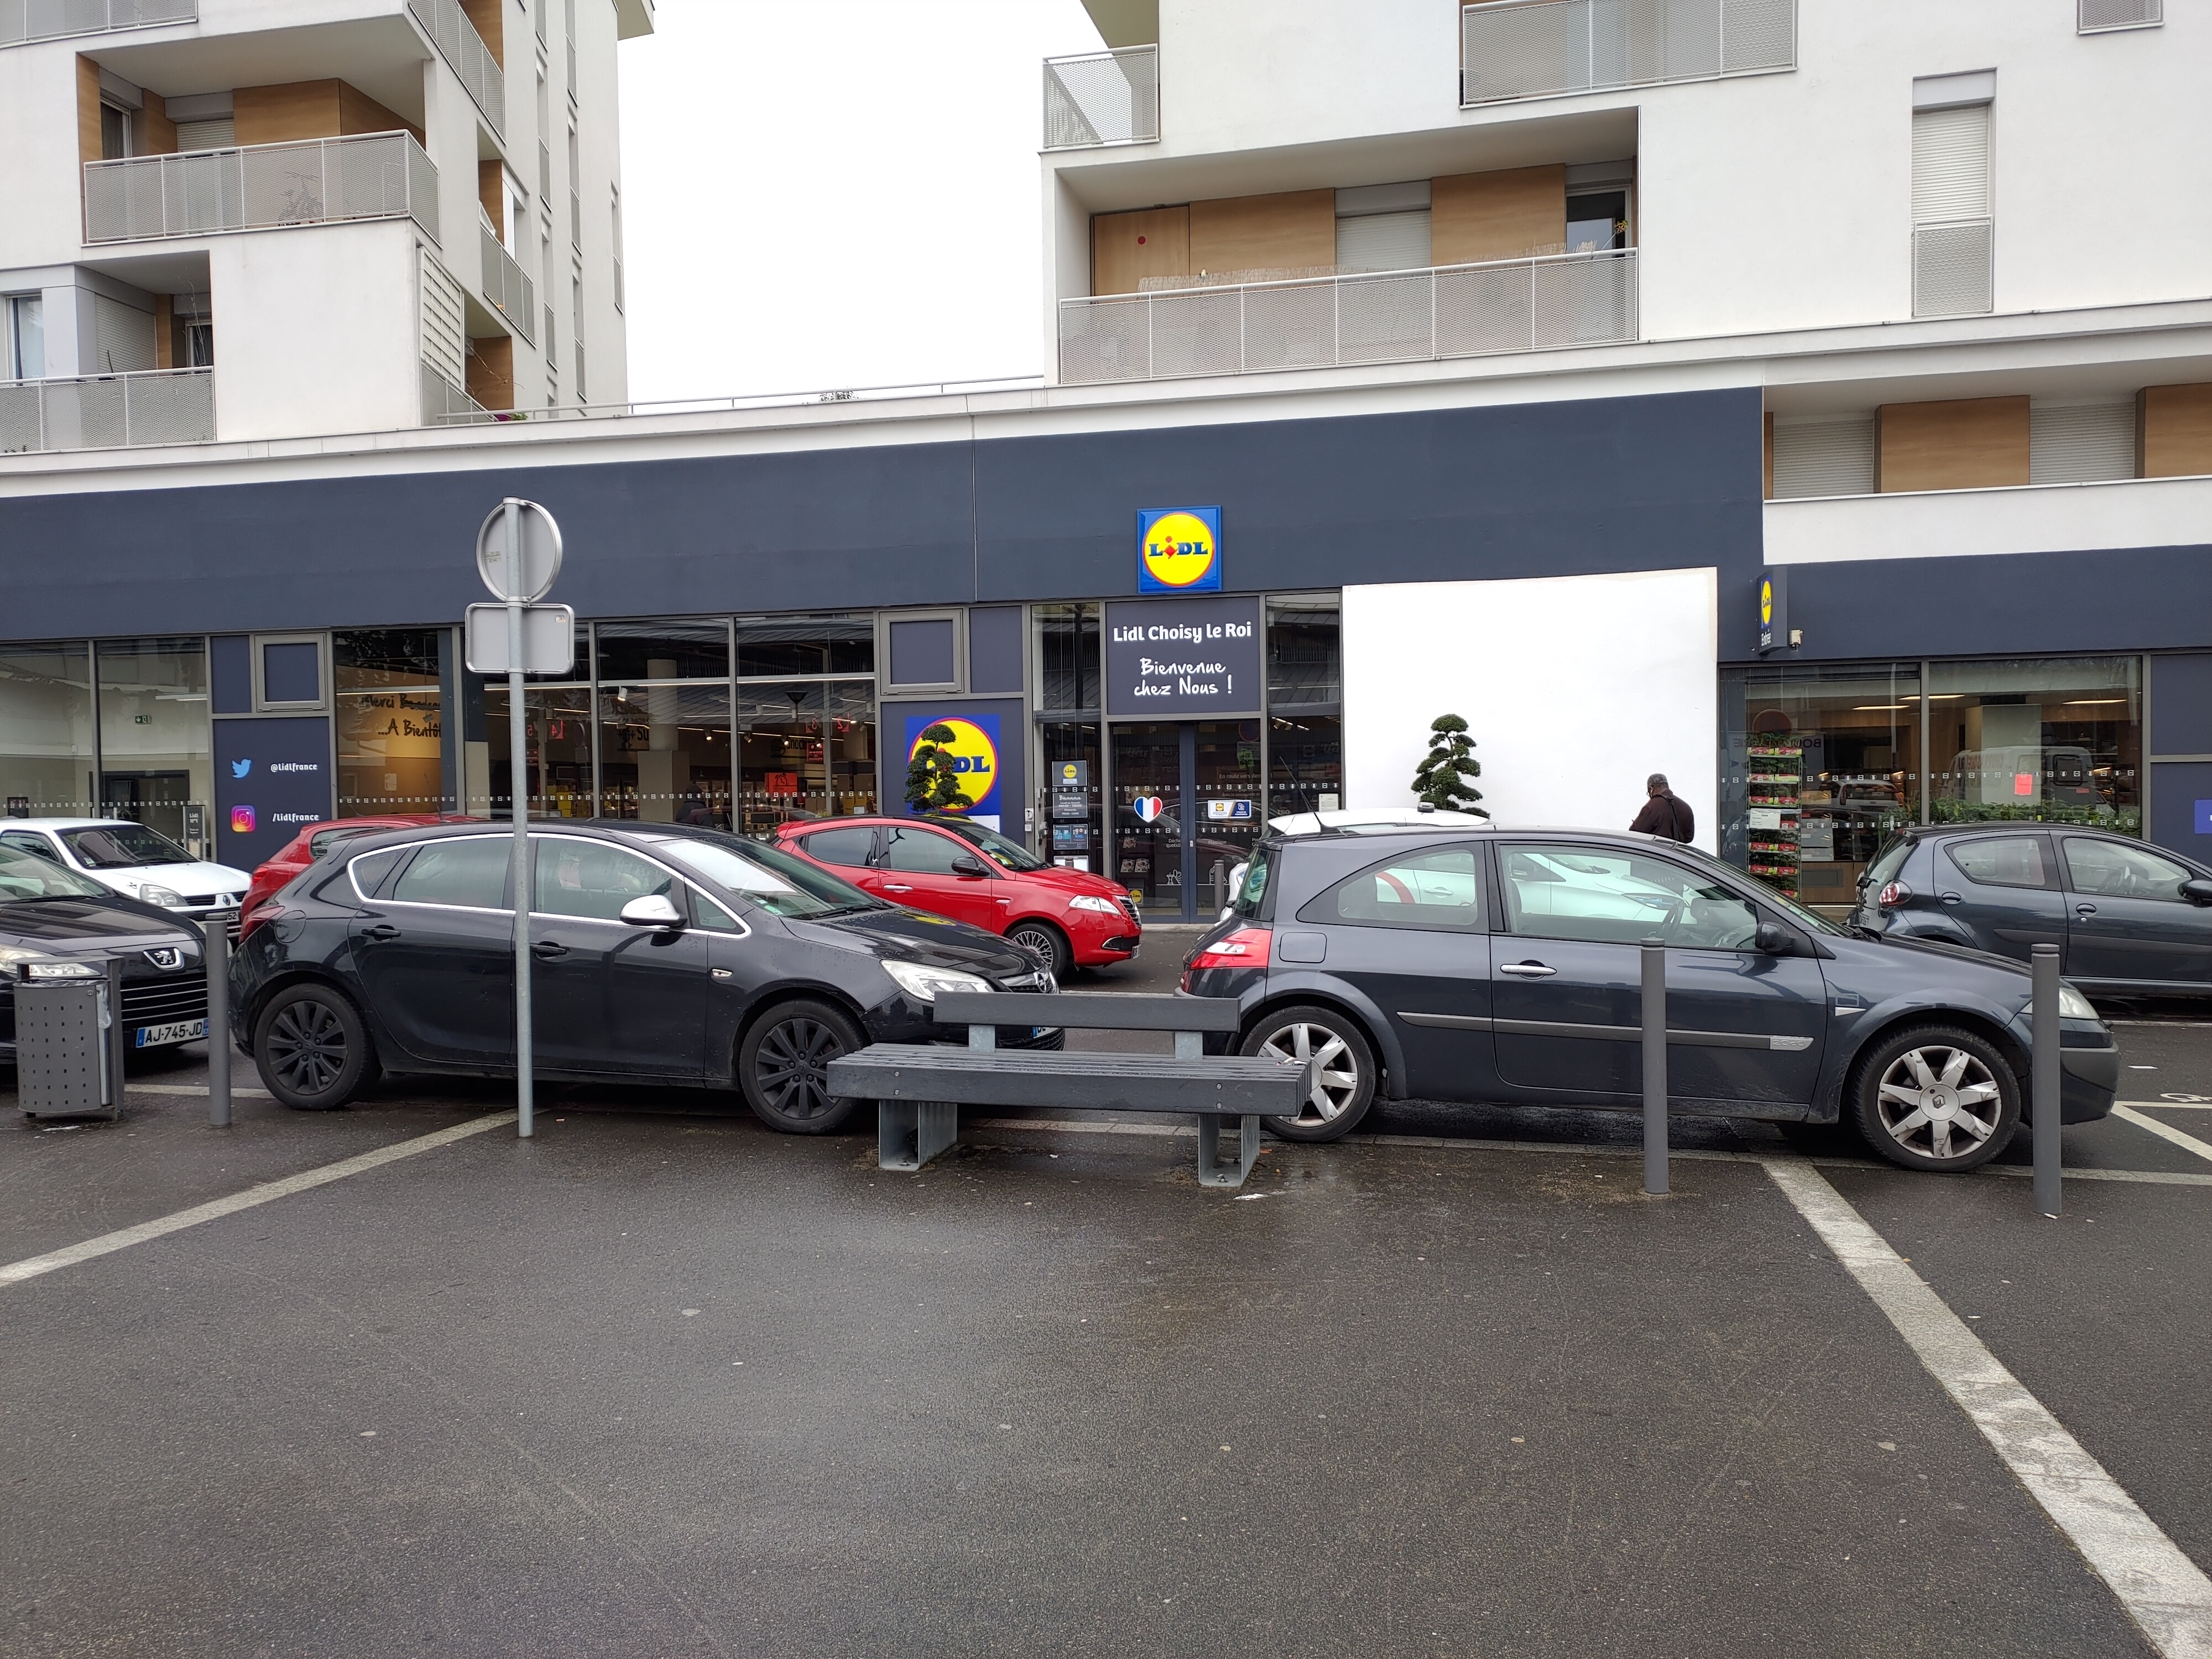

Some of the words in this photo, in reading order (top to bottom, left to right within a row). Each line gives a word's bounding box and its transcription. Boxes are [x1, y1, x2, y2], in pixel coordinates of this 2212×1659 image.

[1113, 625, 1145, 641] Lidl
[1148, 623, 1202, 643] Choisy
[1206, 623, 1222, 638] le
[1225, 621, 1251, 637] Roi
[1140, 657, 1226, 676] Bienvenue
[1134, 679, 1172, 696] chez
[1179, 675, 1219, 695] Nous
[1227, 674, 1233, 694] !
[270, 763, 318, 773] @lidlfrance
[272, 813, 319, 823] /lidlfrance
[145, 1022, 202, 1043] AJ-745-JD
